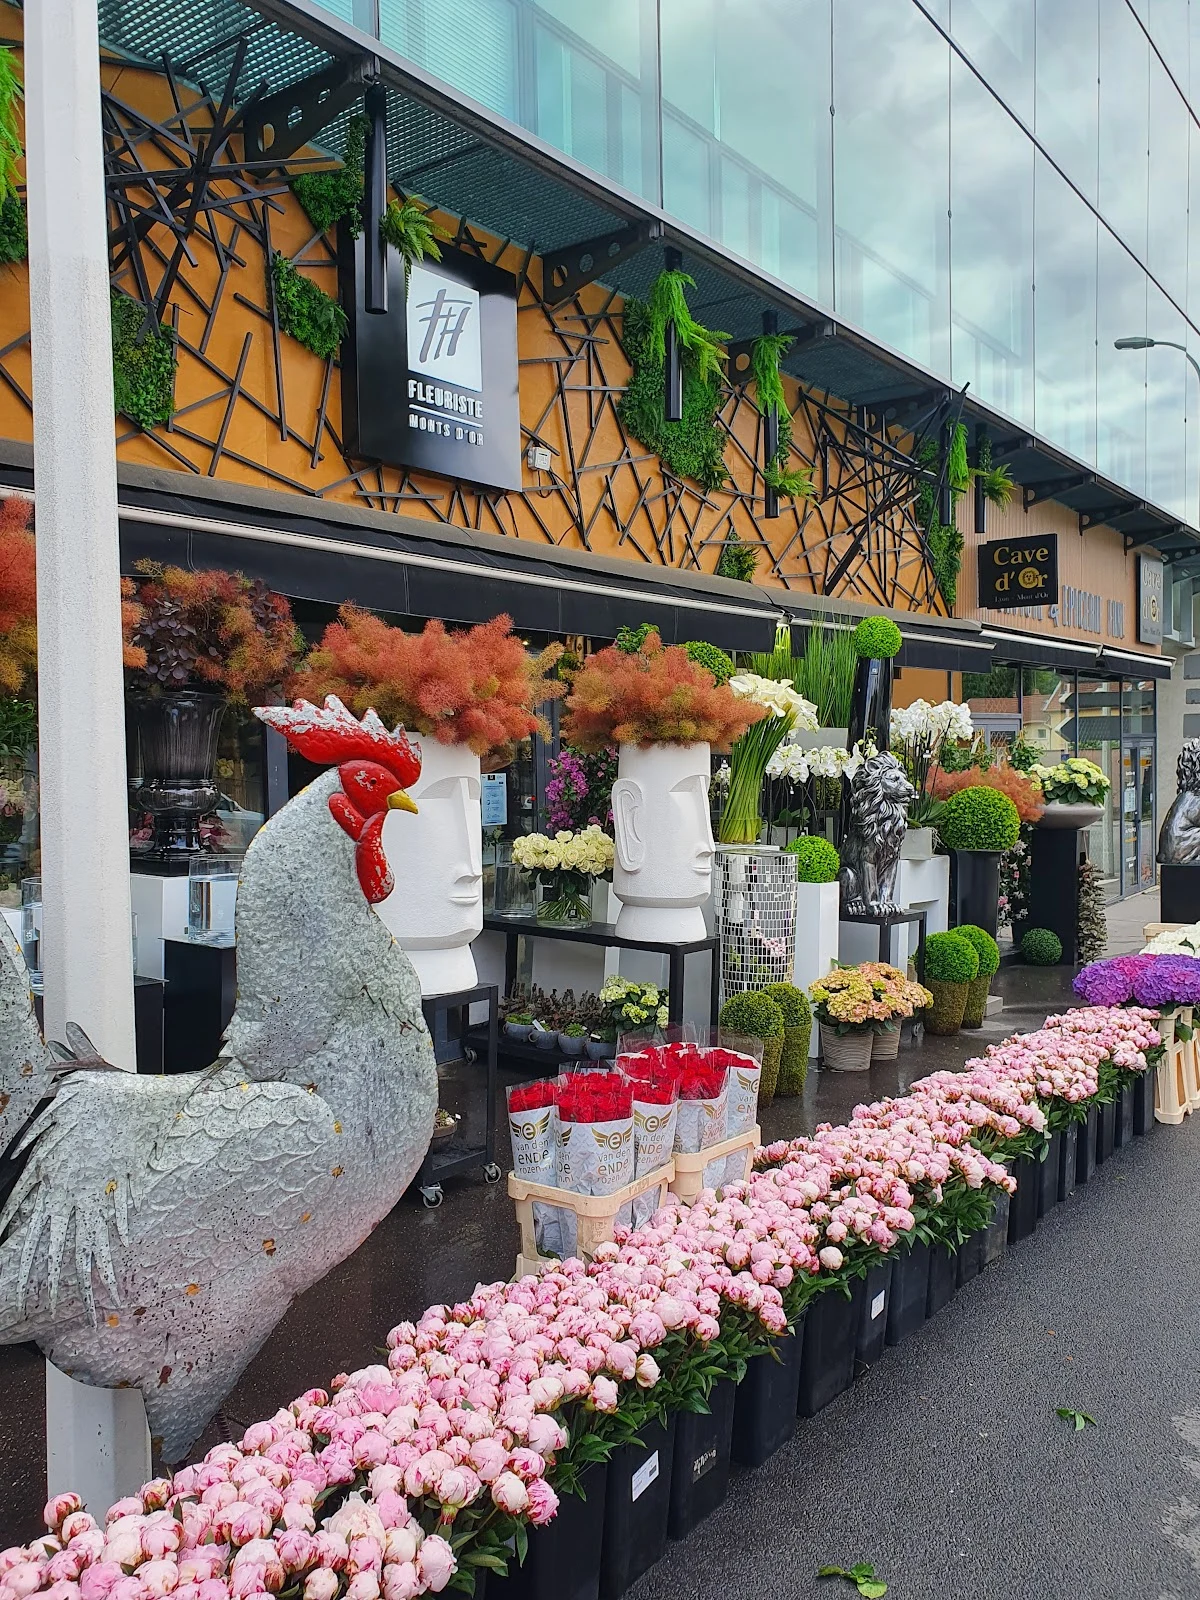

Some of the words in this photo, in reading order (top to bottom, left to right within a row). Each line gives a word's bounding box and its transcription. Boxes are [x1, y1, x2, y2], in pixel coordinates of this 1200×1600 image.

[408, 379, 483, 418] FLEURISTE
[409, 414, 450, 437] MONTS
[455, 427, 484, 446] D'OR
[993, 546, 1049, 566] Cave
[994, 566, 1049, 592] d'Or
[1142, 562, 1161, 591] Cave
[516, 1142, 530, 1152] van
[597, 1153, 614, 1163] van
[615, 1148, 631, 1158] den
